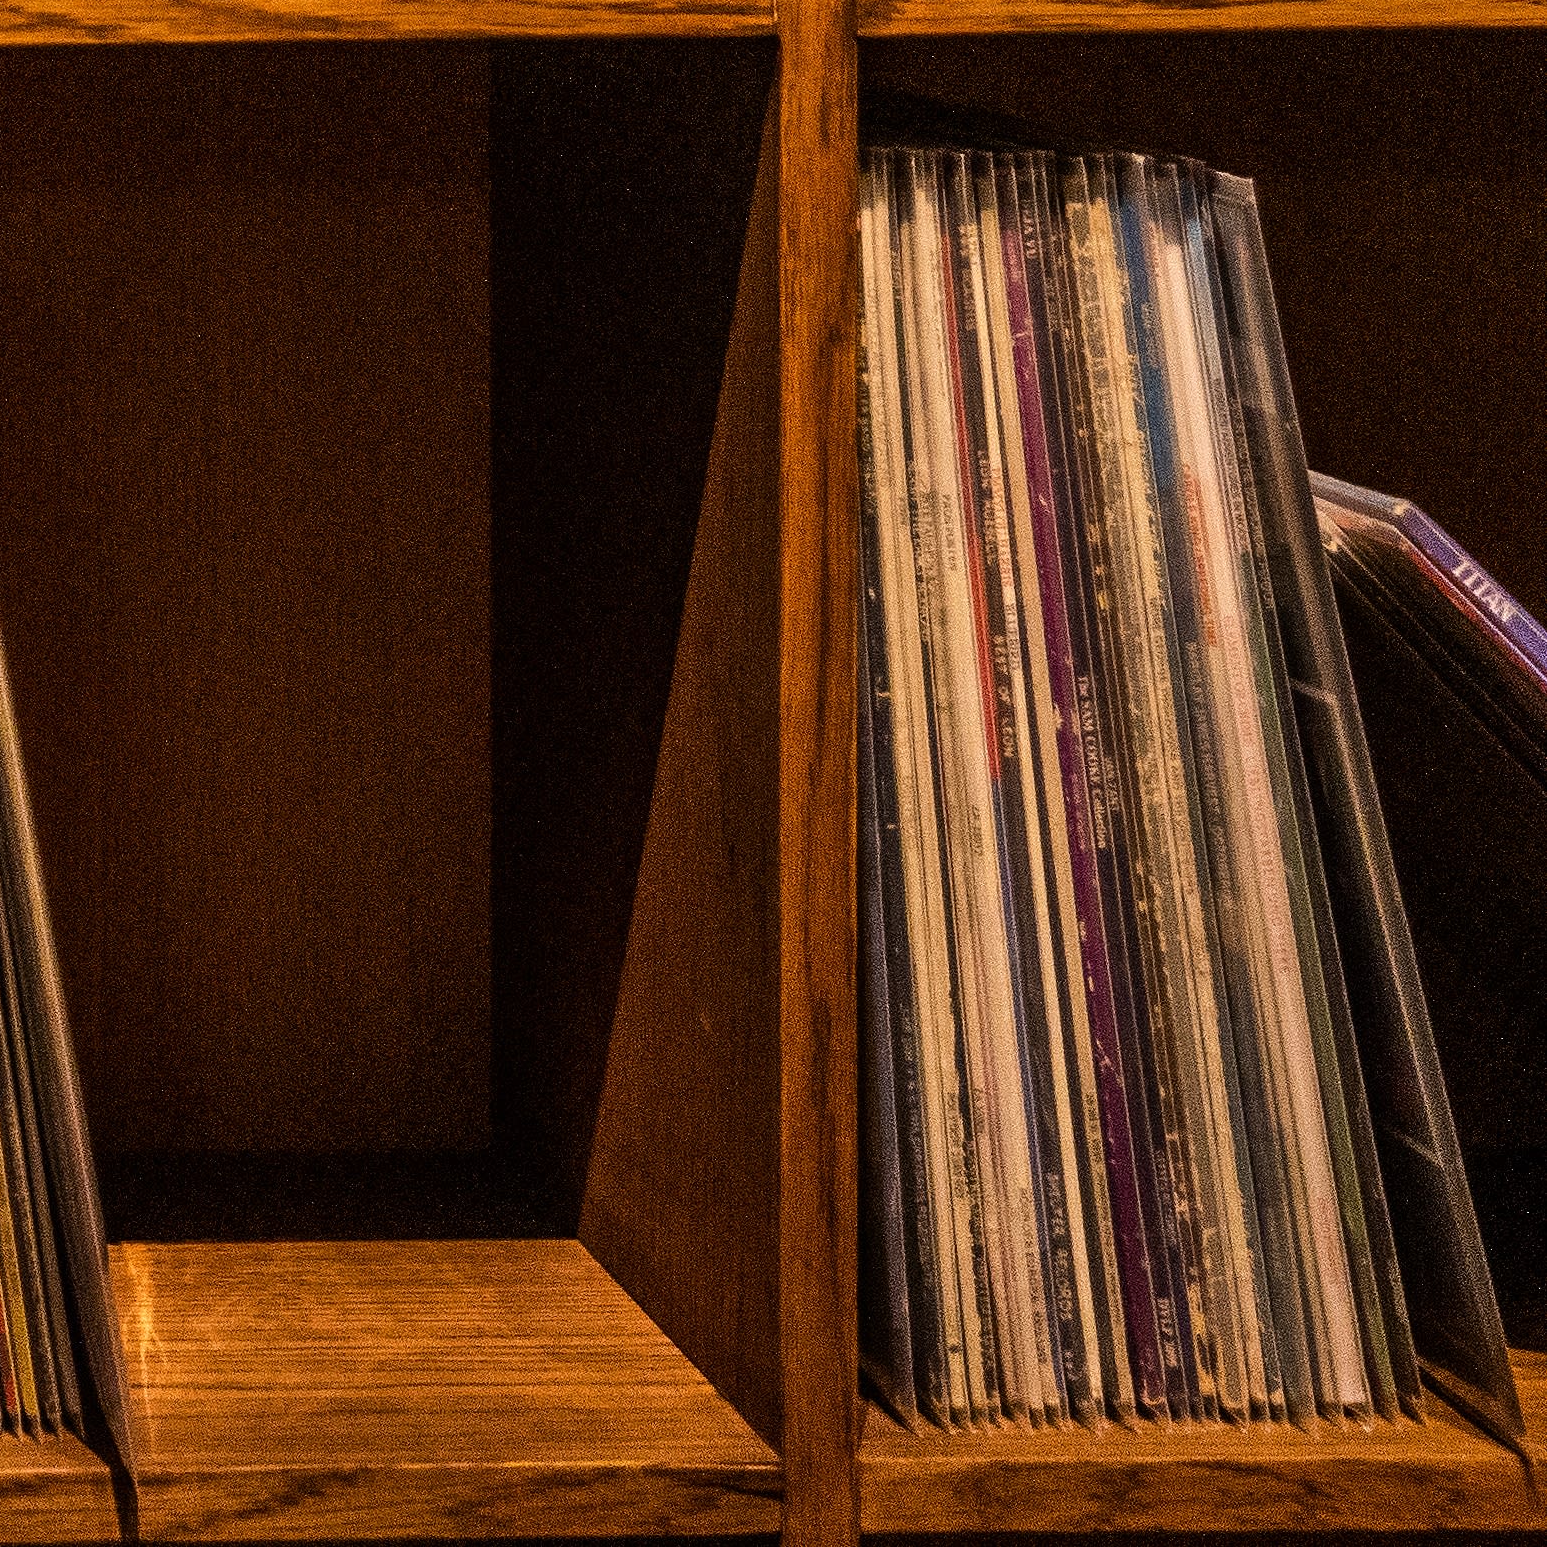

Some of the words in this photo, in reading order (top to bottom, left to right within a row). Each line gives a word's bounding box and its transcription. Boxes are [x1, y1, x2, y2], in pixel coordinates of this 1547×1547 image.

[1077, 674, 1090, 696] The
[1080, 699, 1094, 731] SAM
[1084, 735, 1101, 783] COOKE
[1091, 788, 1109, 849] Collection
